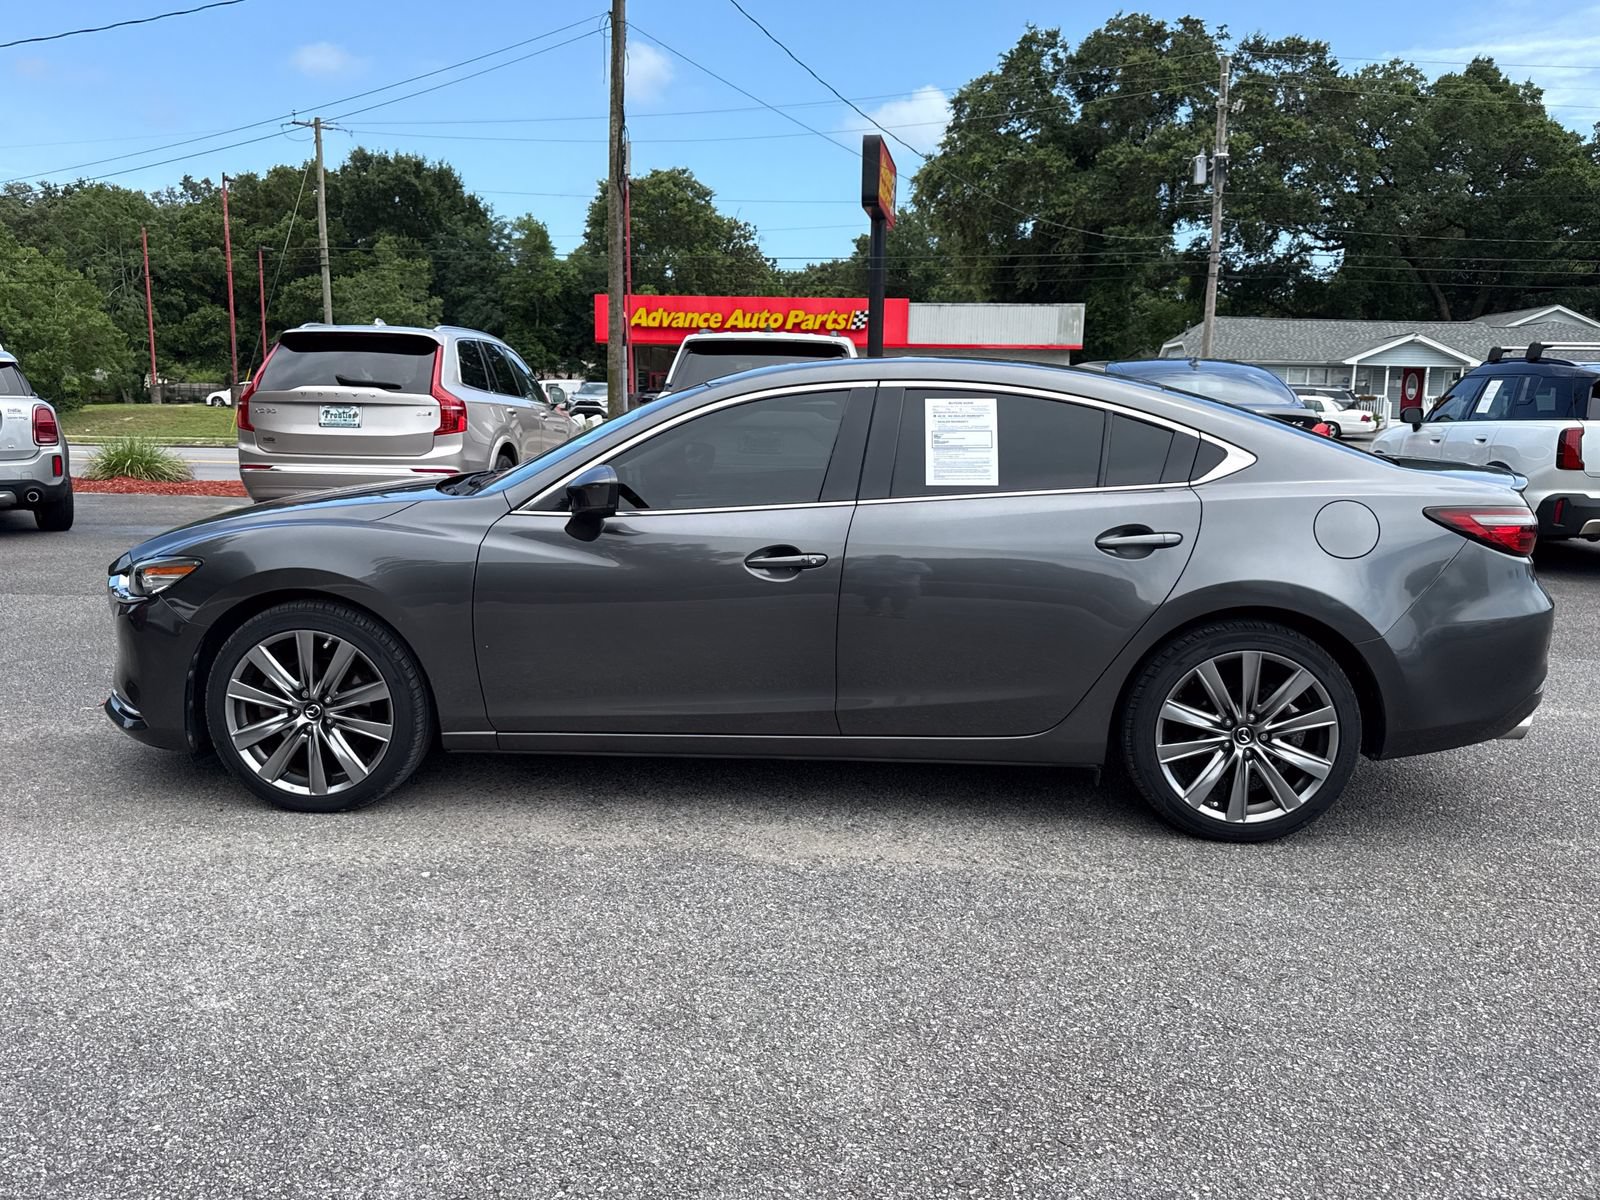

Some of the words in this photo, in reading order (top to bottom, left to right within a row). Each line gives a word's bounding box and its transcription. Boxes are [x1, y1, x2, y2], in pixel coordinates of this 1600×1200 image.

[630, 307, 722, 328] Advance
[724, 308, 783, 329] Auto
[785, 310, 848, 330] Parts
